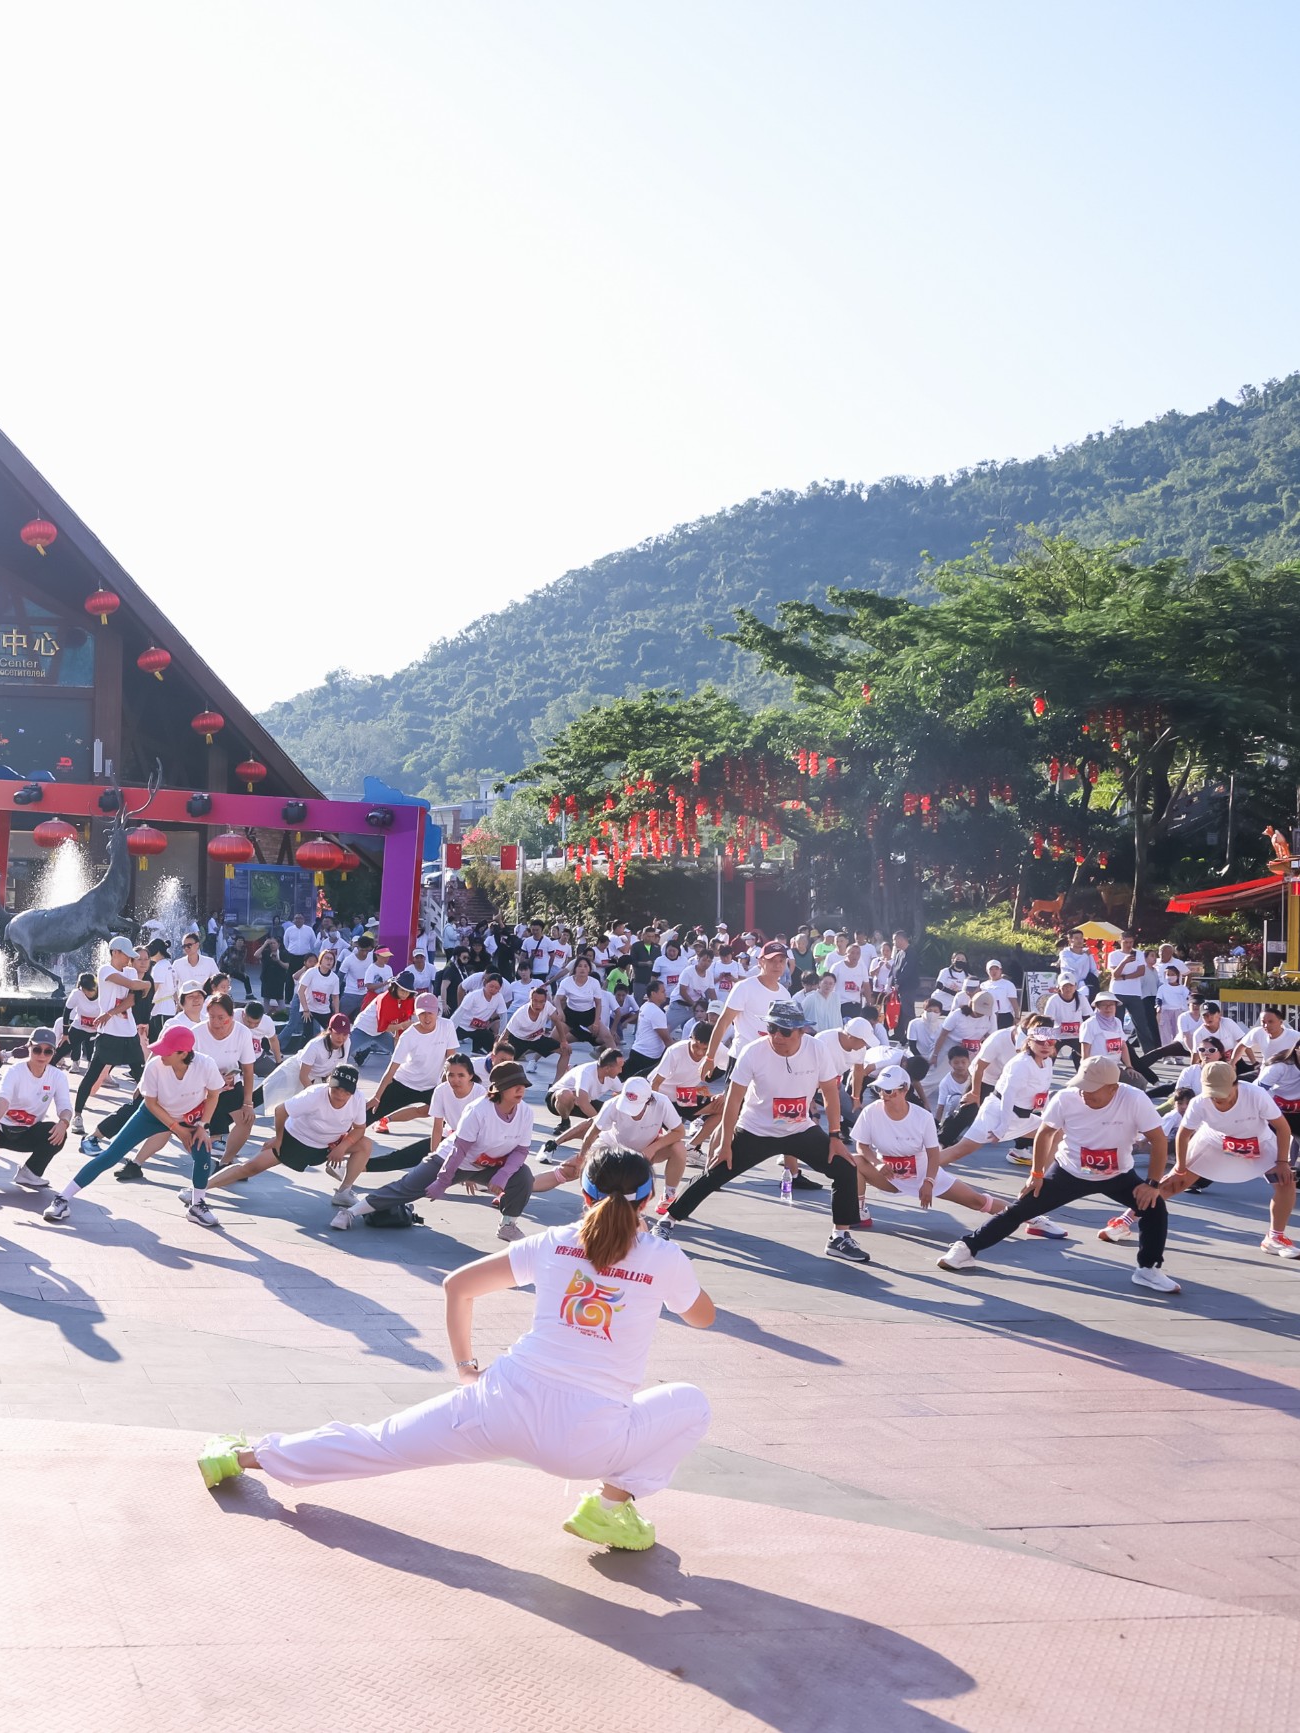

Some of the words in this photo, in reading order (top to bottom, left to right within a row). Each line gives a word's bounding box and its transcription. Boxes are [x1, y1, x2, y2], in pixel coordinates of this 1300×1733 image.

[0, 657, 38, 668] Center
[777, 1102, 804, 1114] 020
[187, 1110, 204, 1123] 02
[1226, 1141, 1255, 1152] 025
[1086, 1154, 1112, 1167] 021
